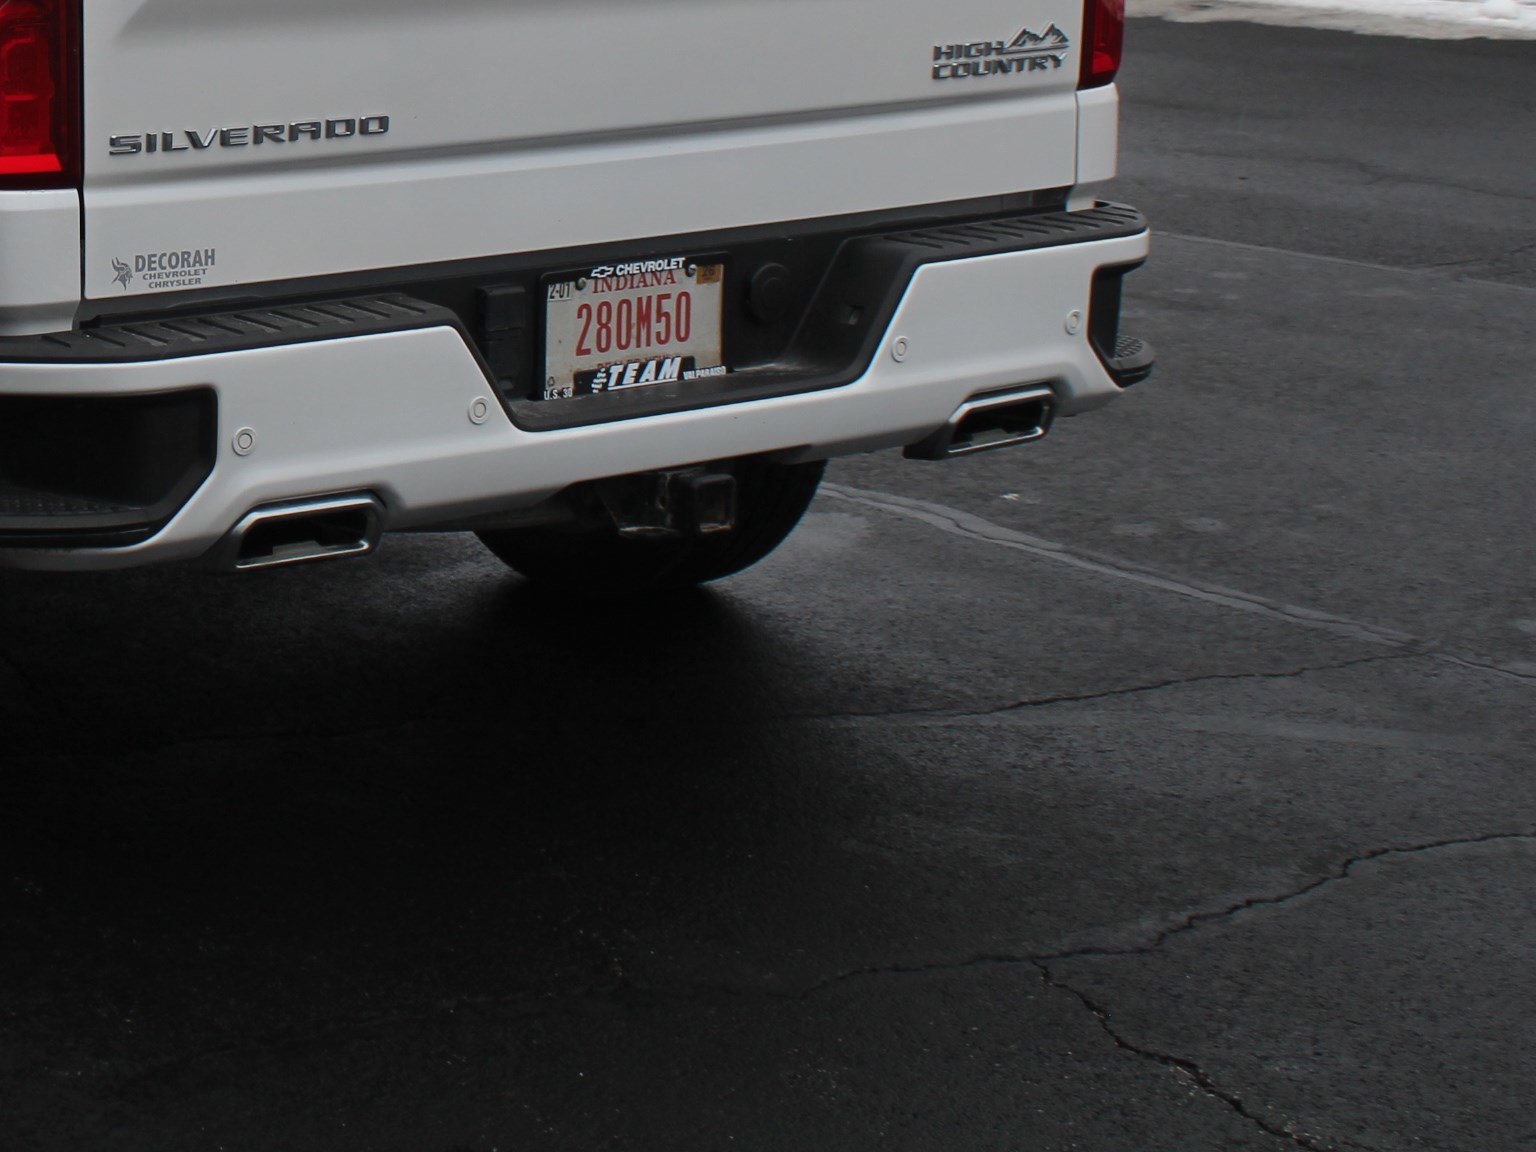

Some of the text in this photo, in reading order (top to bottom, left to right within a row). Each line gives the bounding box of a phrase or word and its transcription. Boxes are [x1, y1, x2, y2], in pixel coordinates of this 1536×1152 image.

[933, 40, 1005, 61] HIGH
[931, 52, 1069, 80] COUNTRY
[109, 115, 389, 155] SILVERADO
[134, 248, 215, 273] DECORAH
[615, 257, 685, 276] CHEVROLET
[142, 268, 208, 281] CHEVROLET
[148, 277, 201, 289] CHRYSLER
[592, 269, 676, 294] INDIANA
[607, 356, 682, 387] TEAM
